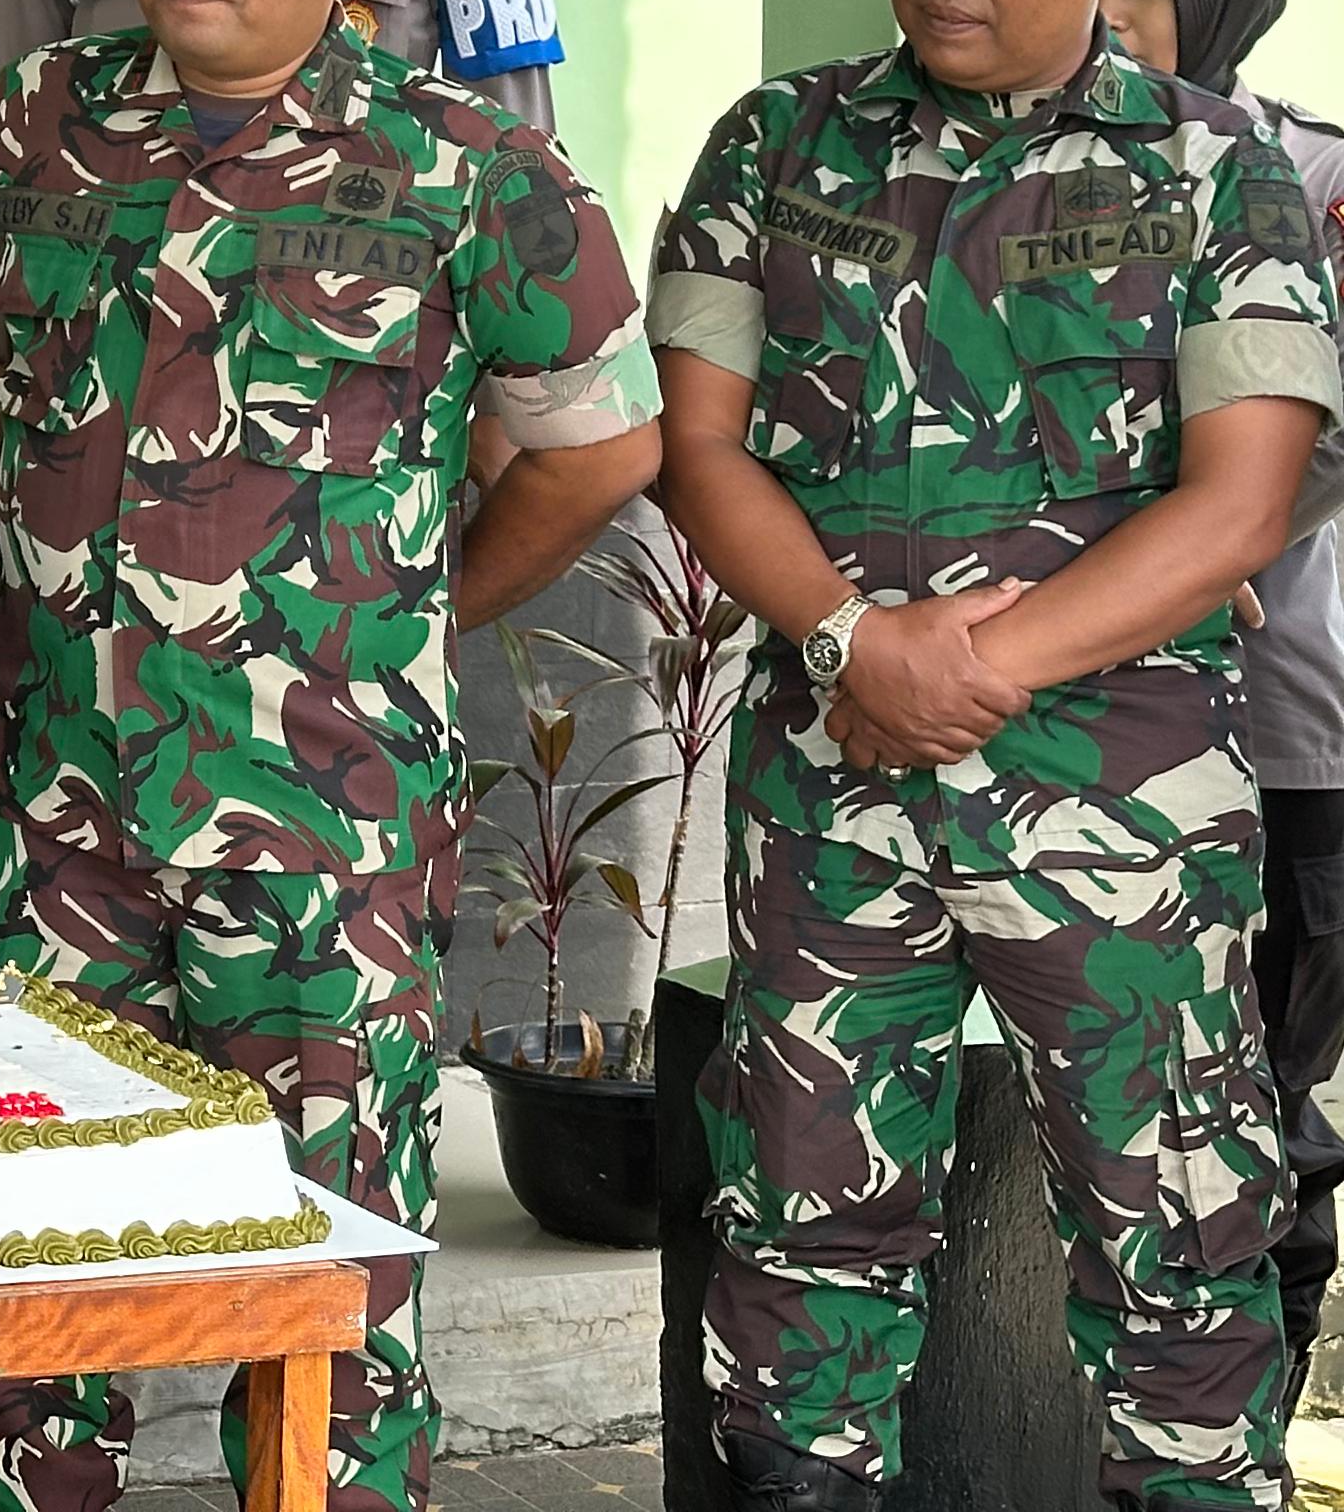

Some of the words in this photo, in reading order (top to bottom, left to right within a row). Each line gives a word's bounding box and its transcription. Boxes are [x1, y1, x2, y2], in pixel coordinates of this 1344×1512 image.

[274, 229, 343, 263] TNI
[363, 240, 420, 276] AD
[1017, 221, 1176, 270] TNI-AD
